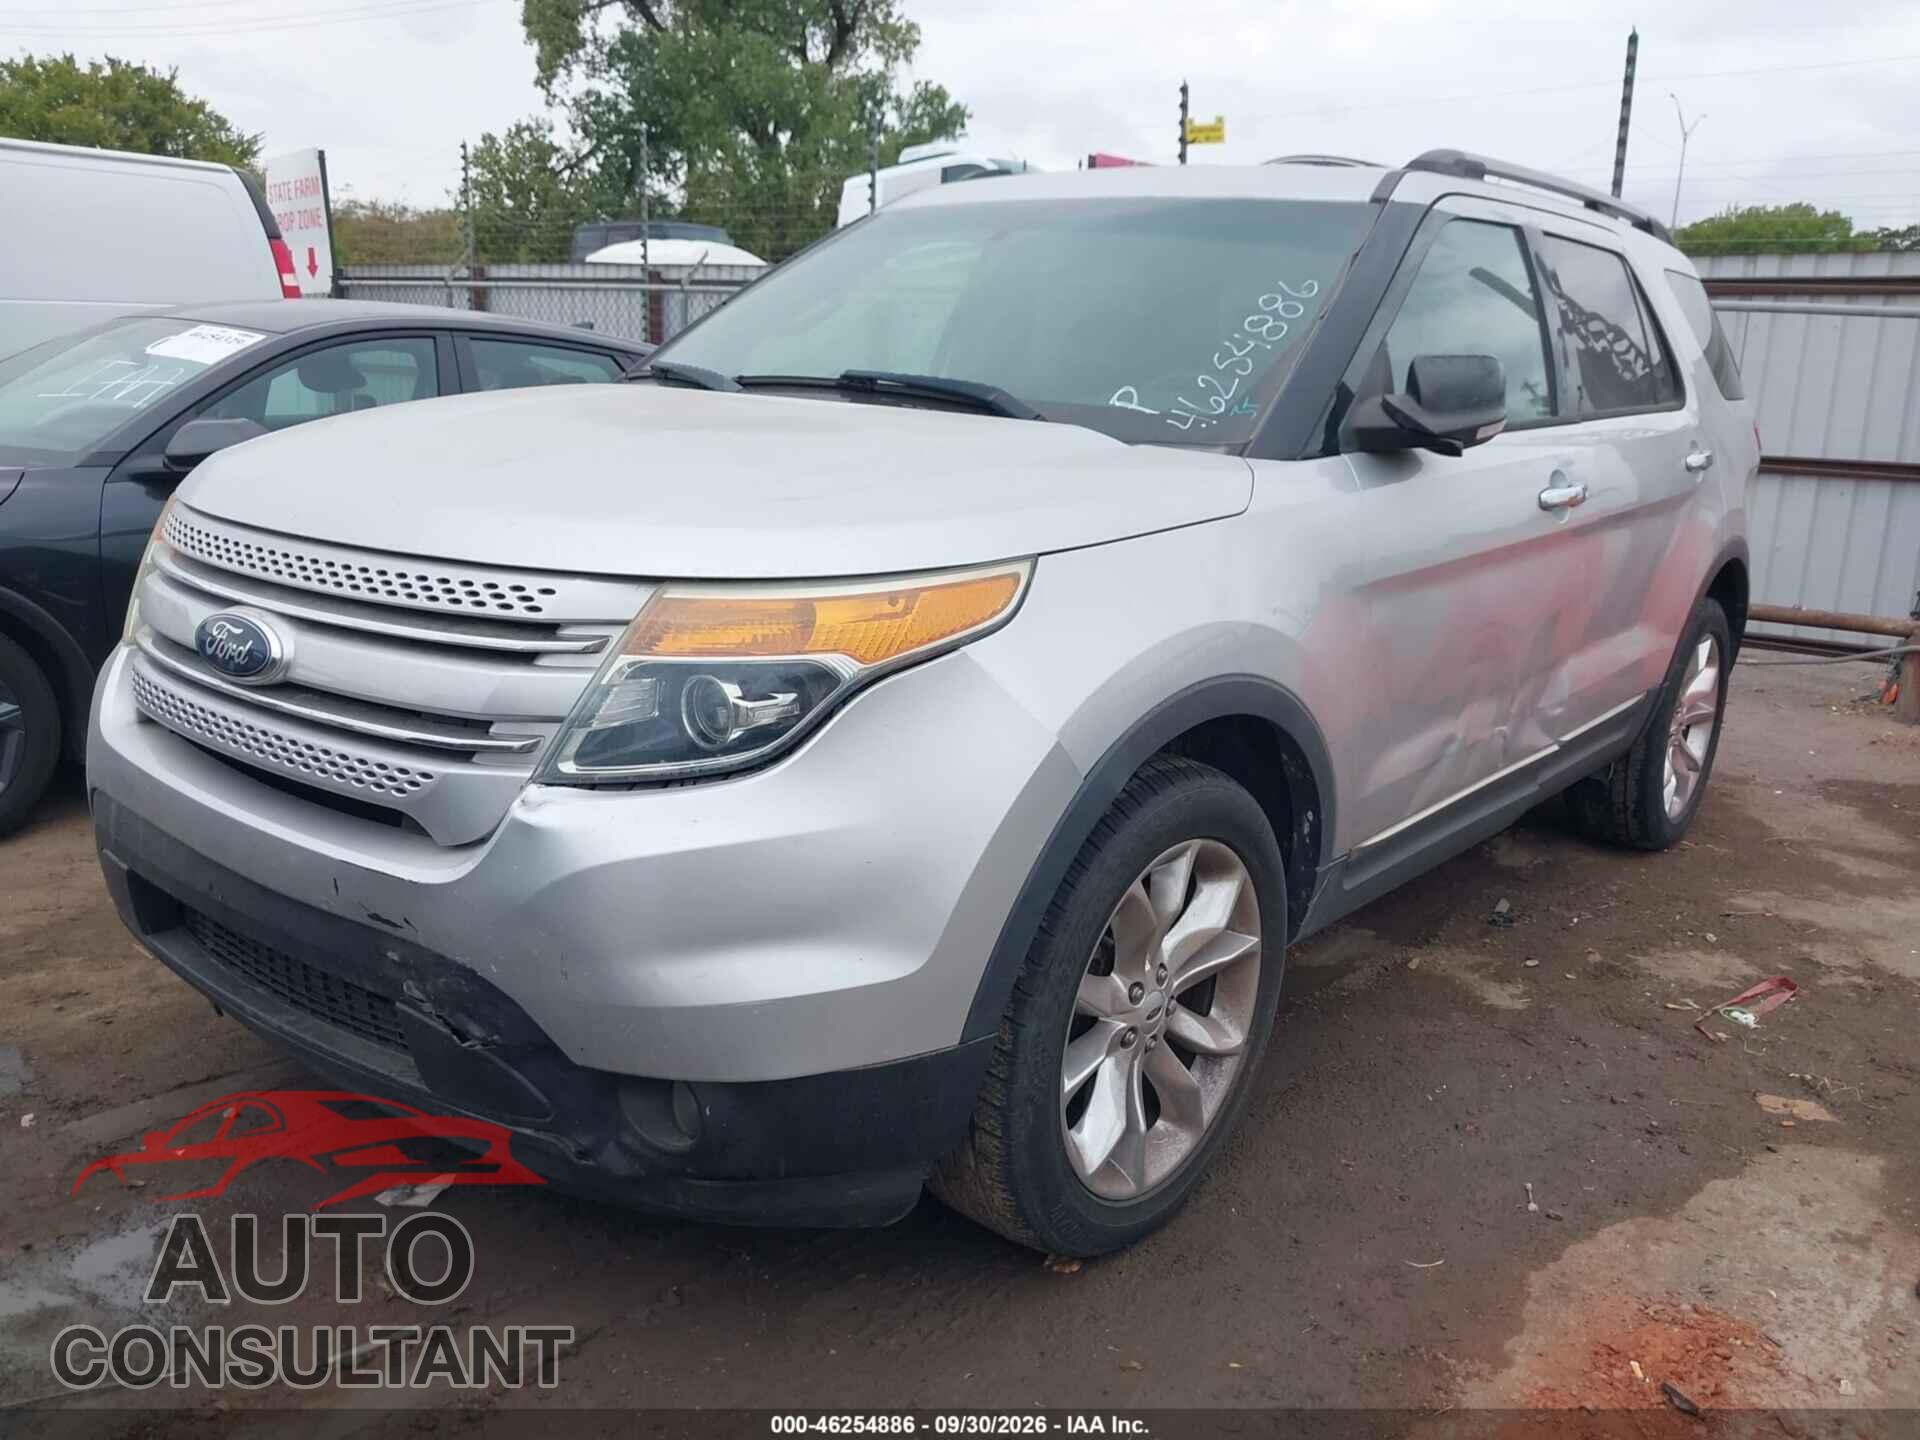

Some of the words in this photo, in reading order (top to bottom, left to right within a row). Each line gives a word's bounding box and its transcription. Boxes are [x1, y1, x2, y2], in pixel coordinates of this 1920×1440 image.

[269, 181, 293, 204] STATE
[294, 176, 321, 200] FARM
[277, 210, 295, 232] ROP
[297, 207, 323, 230] ZONE
[1109, 385, 1161, 415] P
[206, 621, 254, 665] Ford
